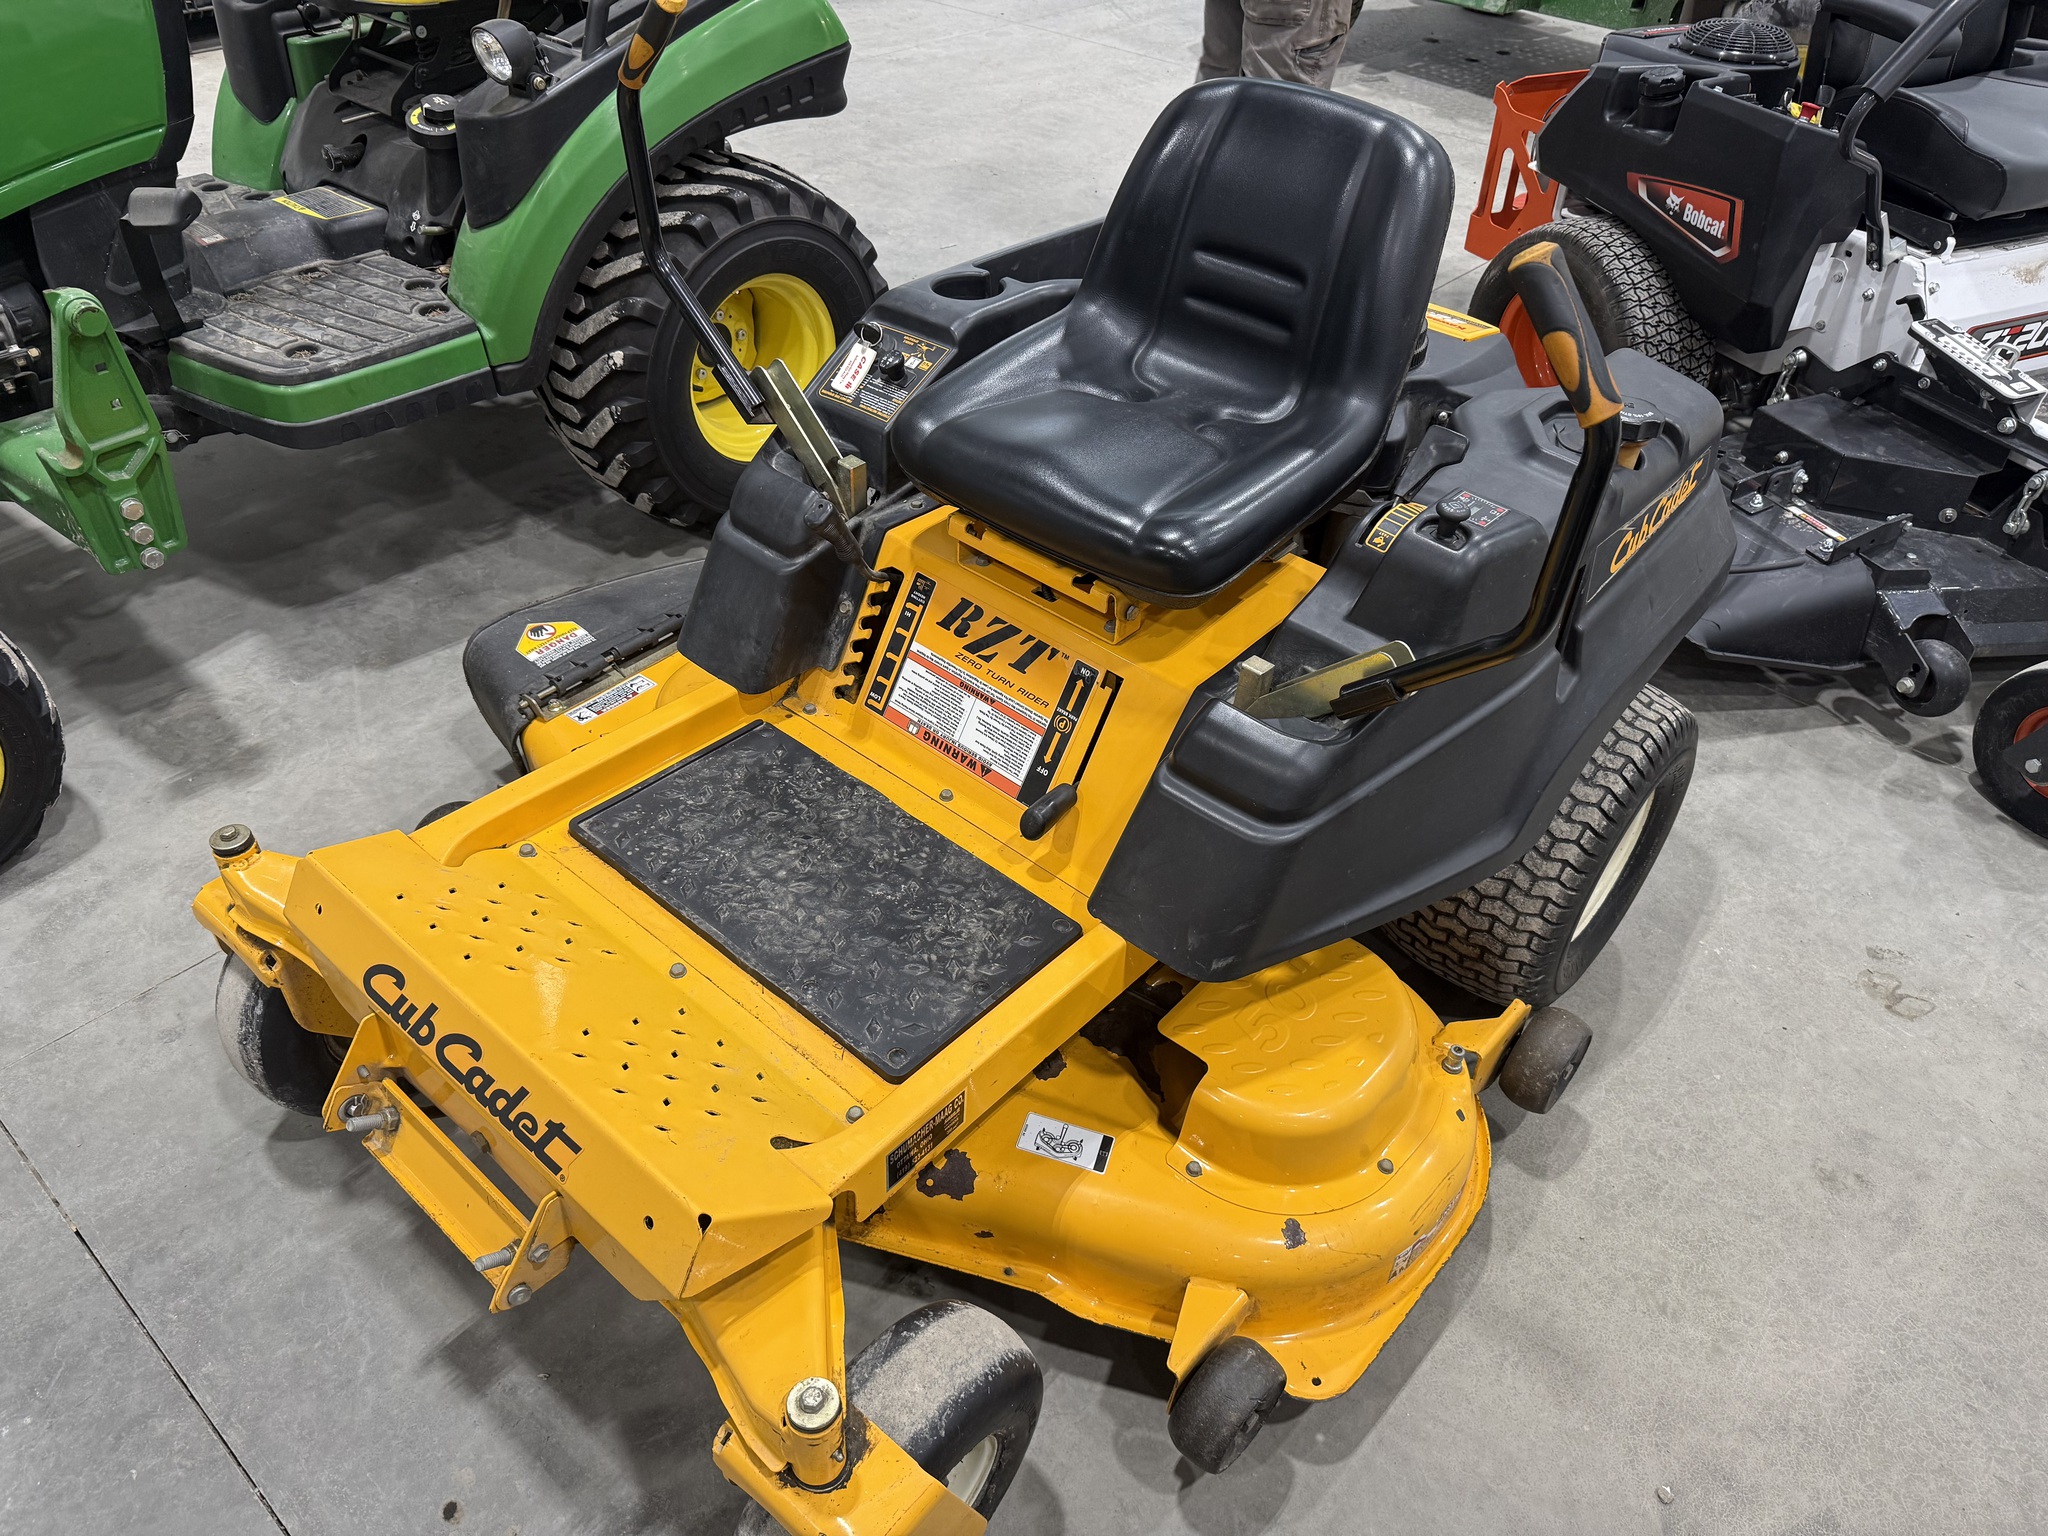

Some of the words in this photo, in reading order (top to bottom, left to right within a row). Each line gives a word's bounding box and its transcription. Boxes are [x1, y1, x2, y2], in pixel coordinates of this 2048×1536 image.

[1683, 202, 1725, 240] Bobcat
[850, 355, 866, 381] CASE
[1610, 514, 1649, 574] Cub
[1649, 458, 1704, 536] Cadet
[534, 631, 577, 656] DANGER
[935, 597, 1061, 675] RZT
[954, 652, 983, 670] ZERO
[985, 668, 1016, 690] TURN
[1016, 686, 1050, 709] RIDER
[1080, 666, 1090, 676] ON
[869, 690, 881, 701] LOW
[958, 680, 990, 702] WARNING
[920, 730, 978, 771] WARNING
[1035, 764, 1049, 775] OFF
[363, 963, 437, 1046] Cub
[435, 1033, 582, 1176] Cadet
[889, 1101, 954, 1166] SCHUMACHER-MAAG
